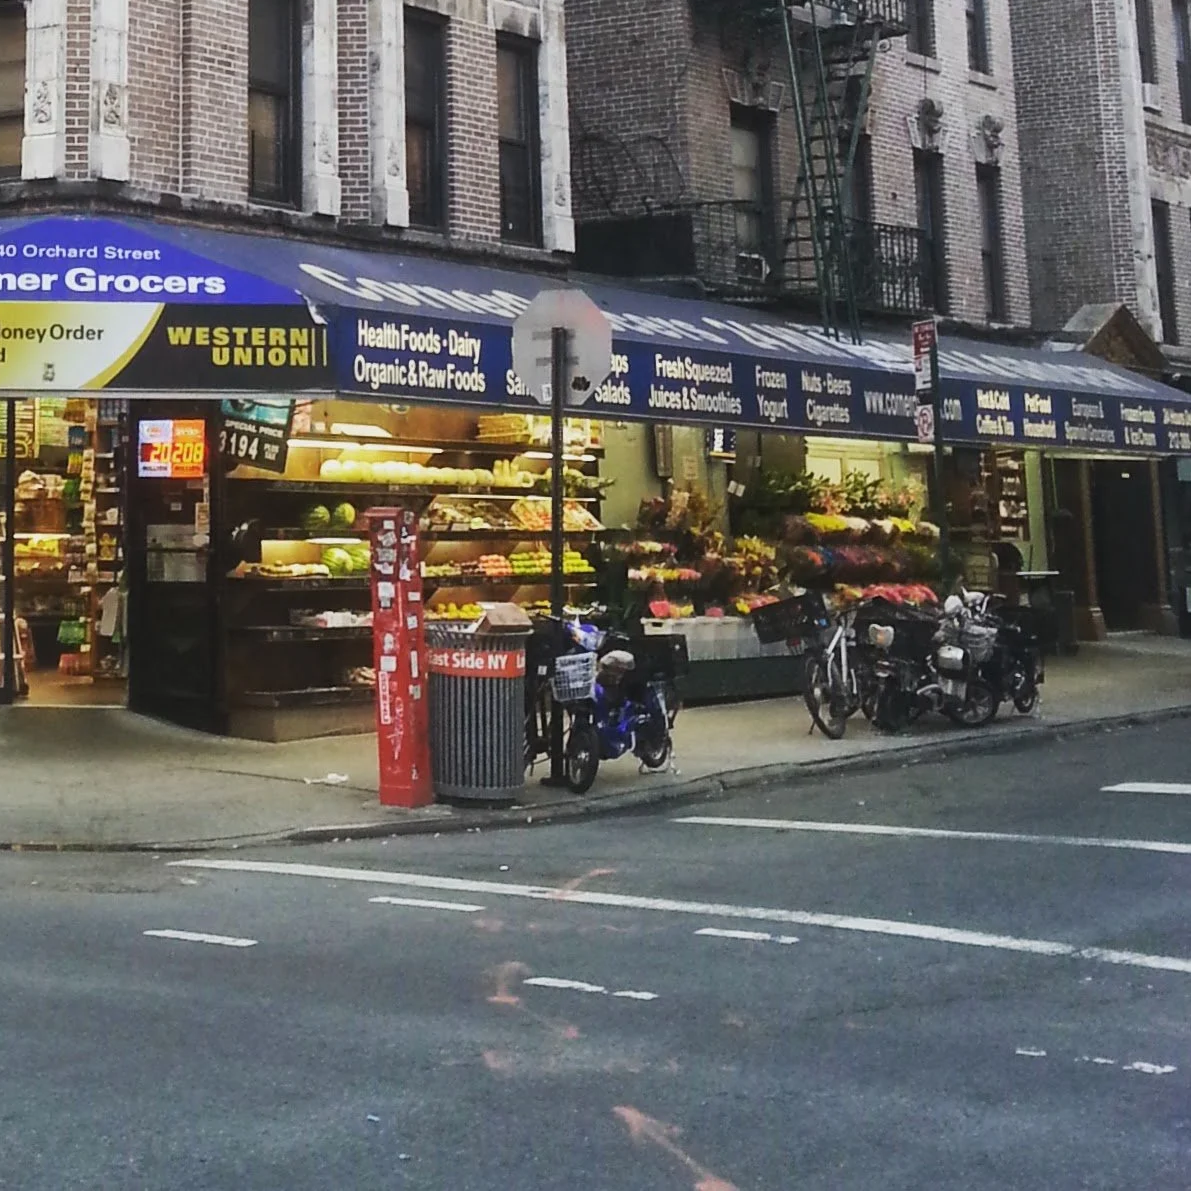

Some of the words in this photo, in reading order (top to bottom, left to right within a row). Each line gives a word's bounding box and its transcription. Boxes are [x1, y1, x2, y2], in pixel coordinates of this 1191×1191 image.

[23, 244, 98, 259] Orchard
[104, 246, 161, 261] Street
[65, 267, 226, 294] Grocers
[50, 323, 104, 341] Order
[167, 327, 309, 346] WESTERN
[358, 319, 400, 350] Health
[400, 324, 441, 355] Foods
[448, 329, 482, 365] Dairy
[212, 347, 309, 366] UNION
[354, 354, 407, 390] Organic
[407, 359, 418, 386] &
[418, 360, 447, 388] Raw
[446, 363, 486, 393] Foods
[655, 353, 684, 378] Fresh
[684, 357, 733, 386] Squeezed
[755, 365, 787, 389] Frozen
[801, 370, 822, 393] Nuts
[826, 373, 852, 396] Beers
[648, 384, 682, 409] Juices
[681, 386, 691, 410] &
[690, 388, 742, 415] Smoothies
[757, 394, 789, 423] Yogurt
[806, 398, 851, 427] Cigarettes
[224, 419, 257, 434] SPECIAL
[259, 426, 283, 439] PRICE
[150, 442, 172, 464] 20
[172, 442, 204, 464] 208
[452, 649, 484, 669] Side
[487, 653, 508, 670] NY
